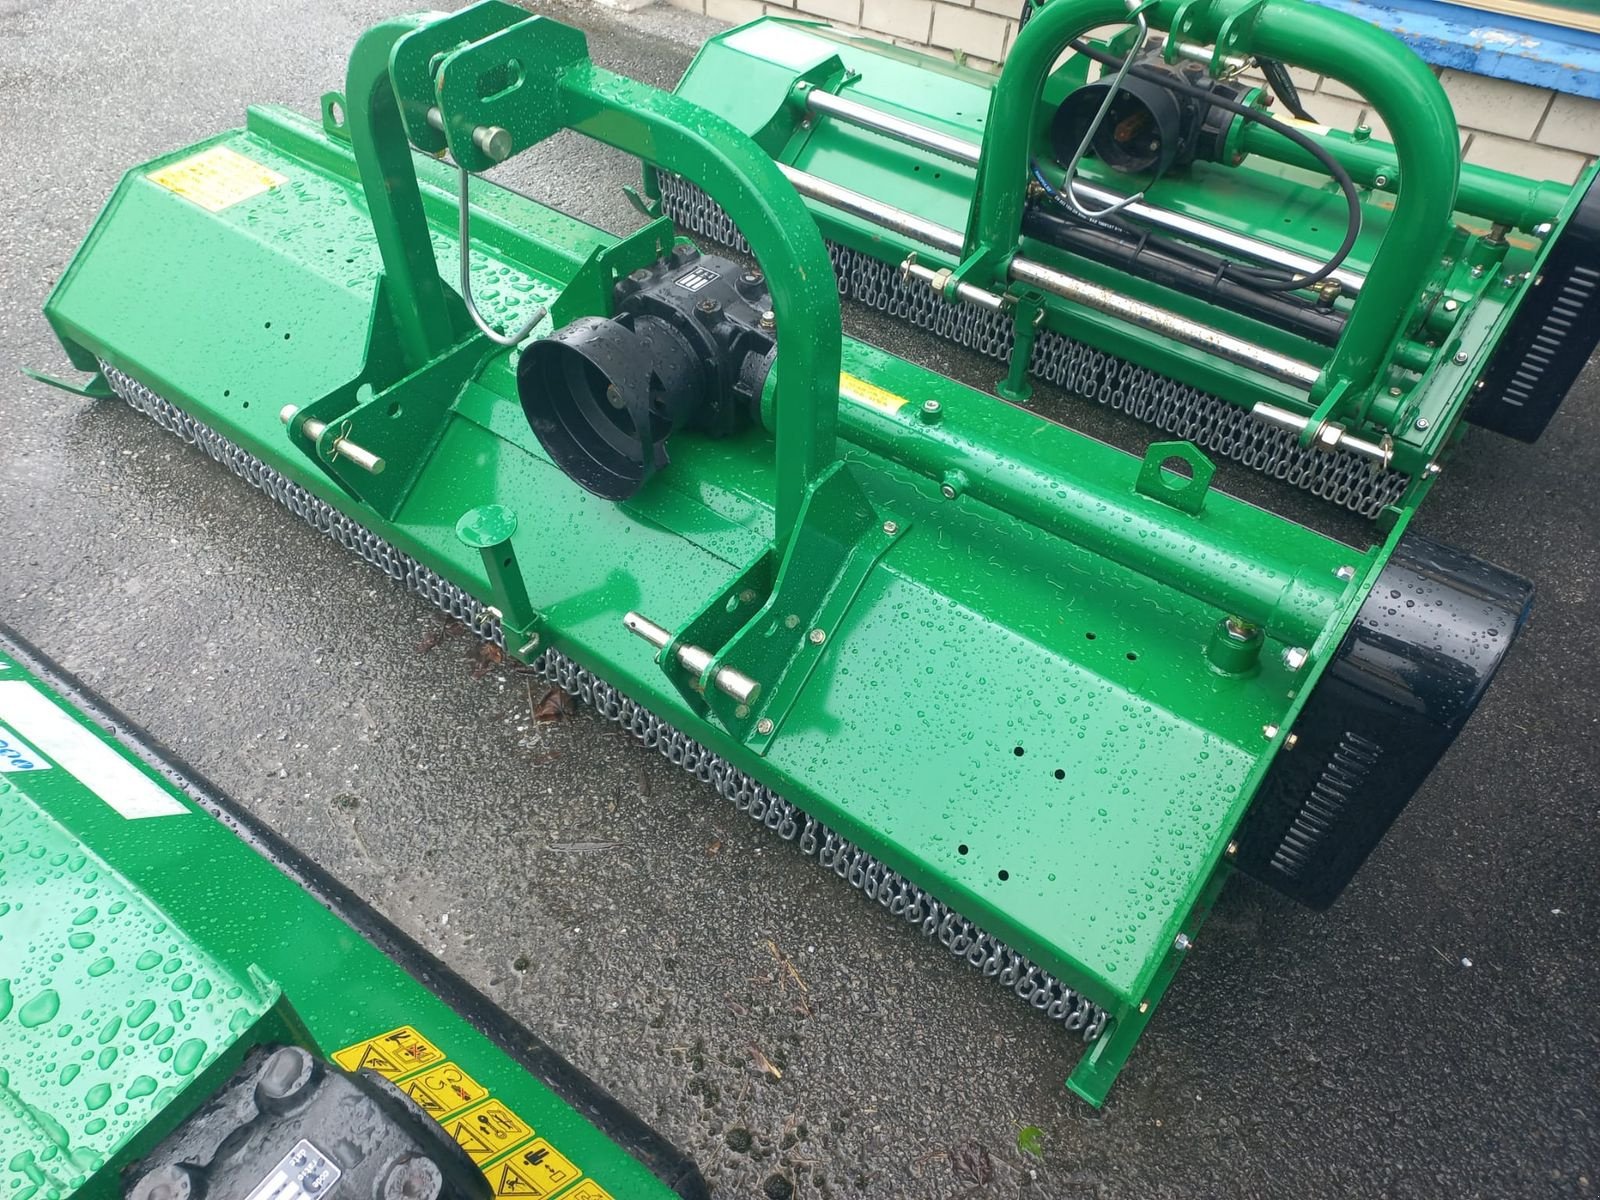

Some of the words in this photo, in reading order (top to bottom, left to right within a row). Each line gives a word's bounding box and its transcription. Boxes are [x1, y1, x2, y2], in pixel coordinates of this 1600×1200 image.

[289, 1149, 306, 1167] date
[297, 1159, 318, 1180] ratio
[311, 1169, 329, 1188] code
